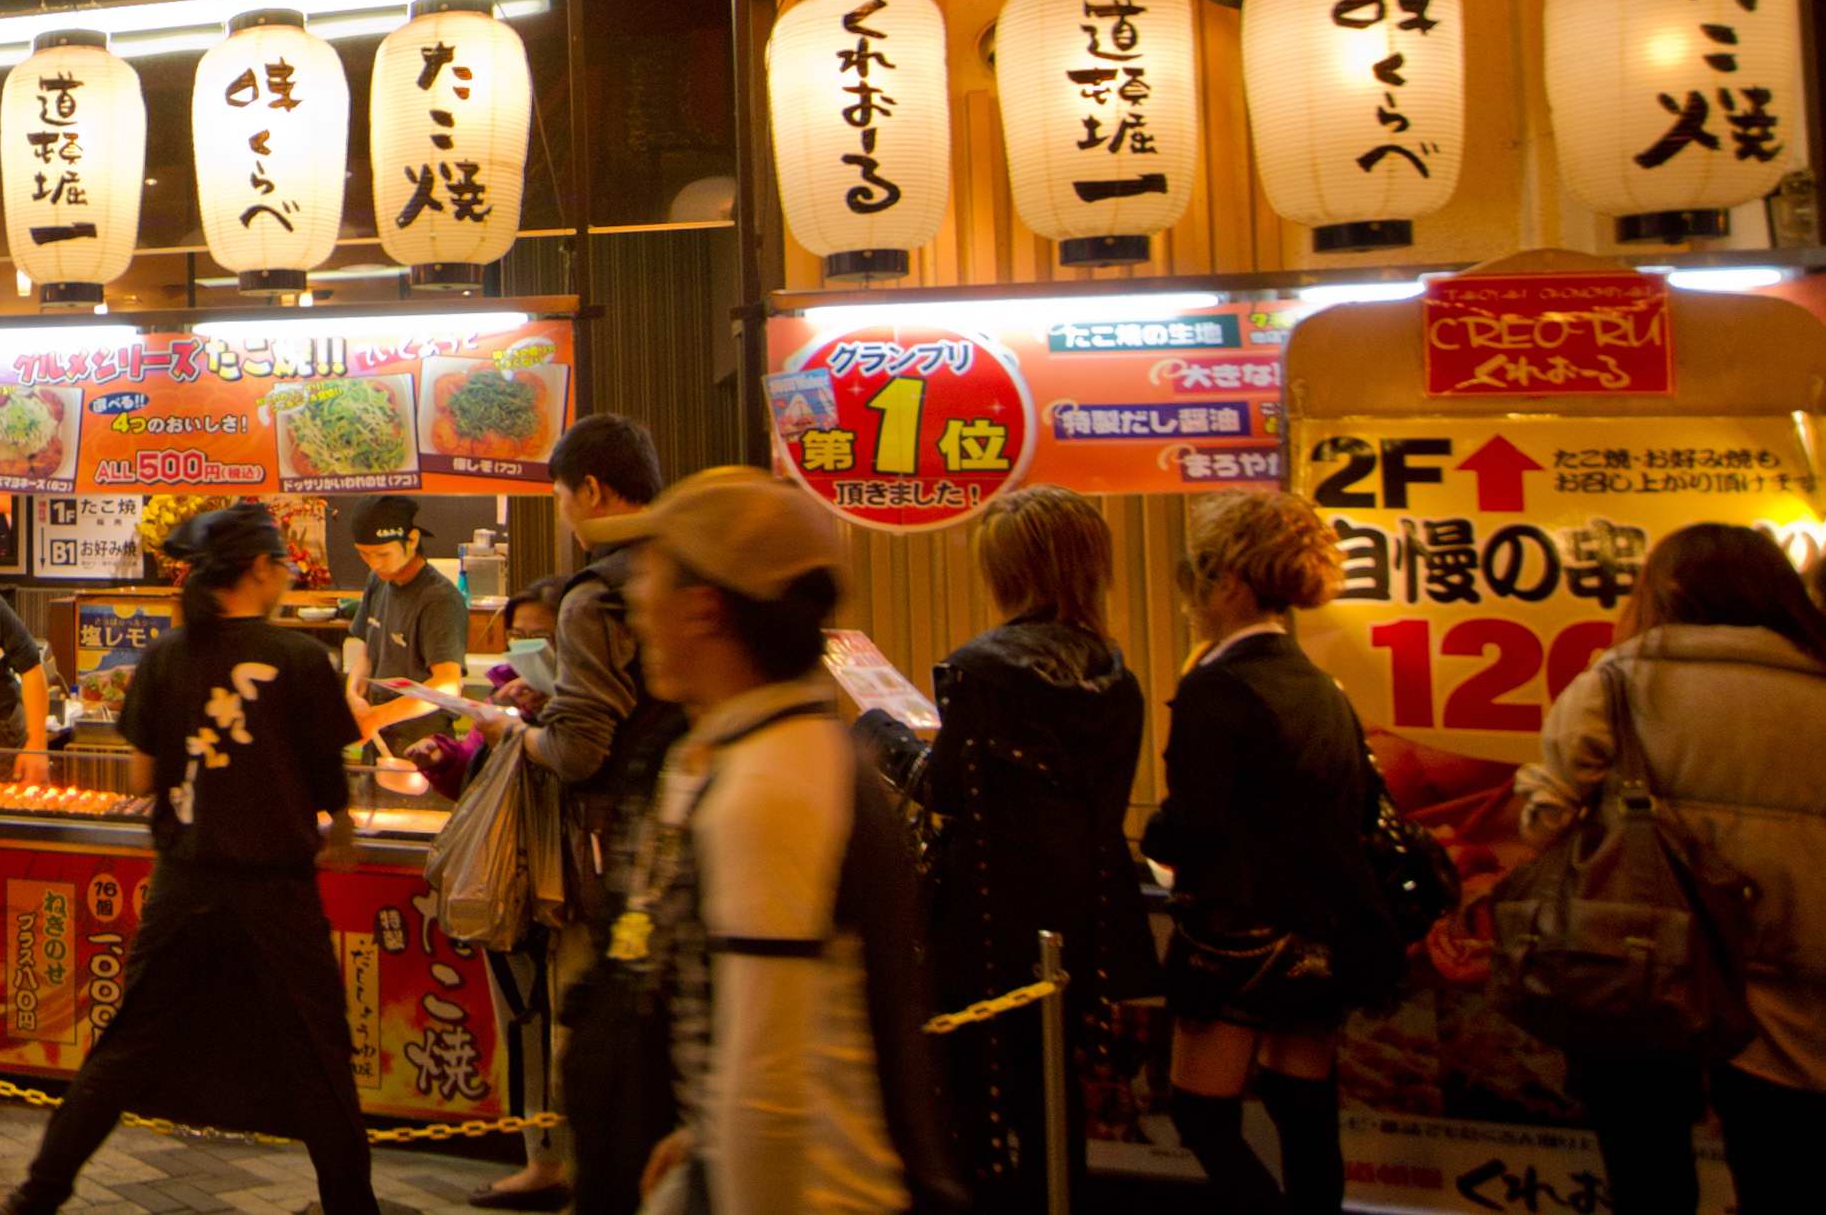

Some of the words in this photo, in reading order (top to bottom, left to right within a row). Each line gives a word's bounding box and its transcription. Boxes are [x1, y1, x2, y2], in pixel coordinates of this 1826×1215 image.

[224, 57, 303, 234] 味くらべ
[395, 40, 493, 228] たこ焼
[829, 341, 972, 375] グランプリ
[1182, 362, 1281, 388] 大きな
[802, 376, 1011, 475] 第1位
[94, 460, 136, 484] ALL
[1311, 436, 1452, 510] 2F
[53, 502, 76, 523] 1F
[81, 499, 136, 514] たこ焼
[835, 482, 980, 506] 頂きました!
[53, 542, 76, 563] B1
[81, 540, 137, 556] お好み焼
[43, 890, 68, 986] ねぎのせ
